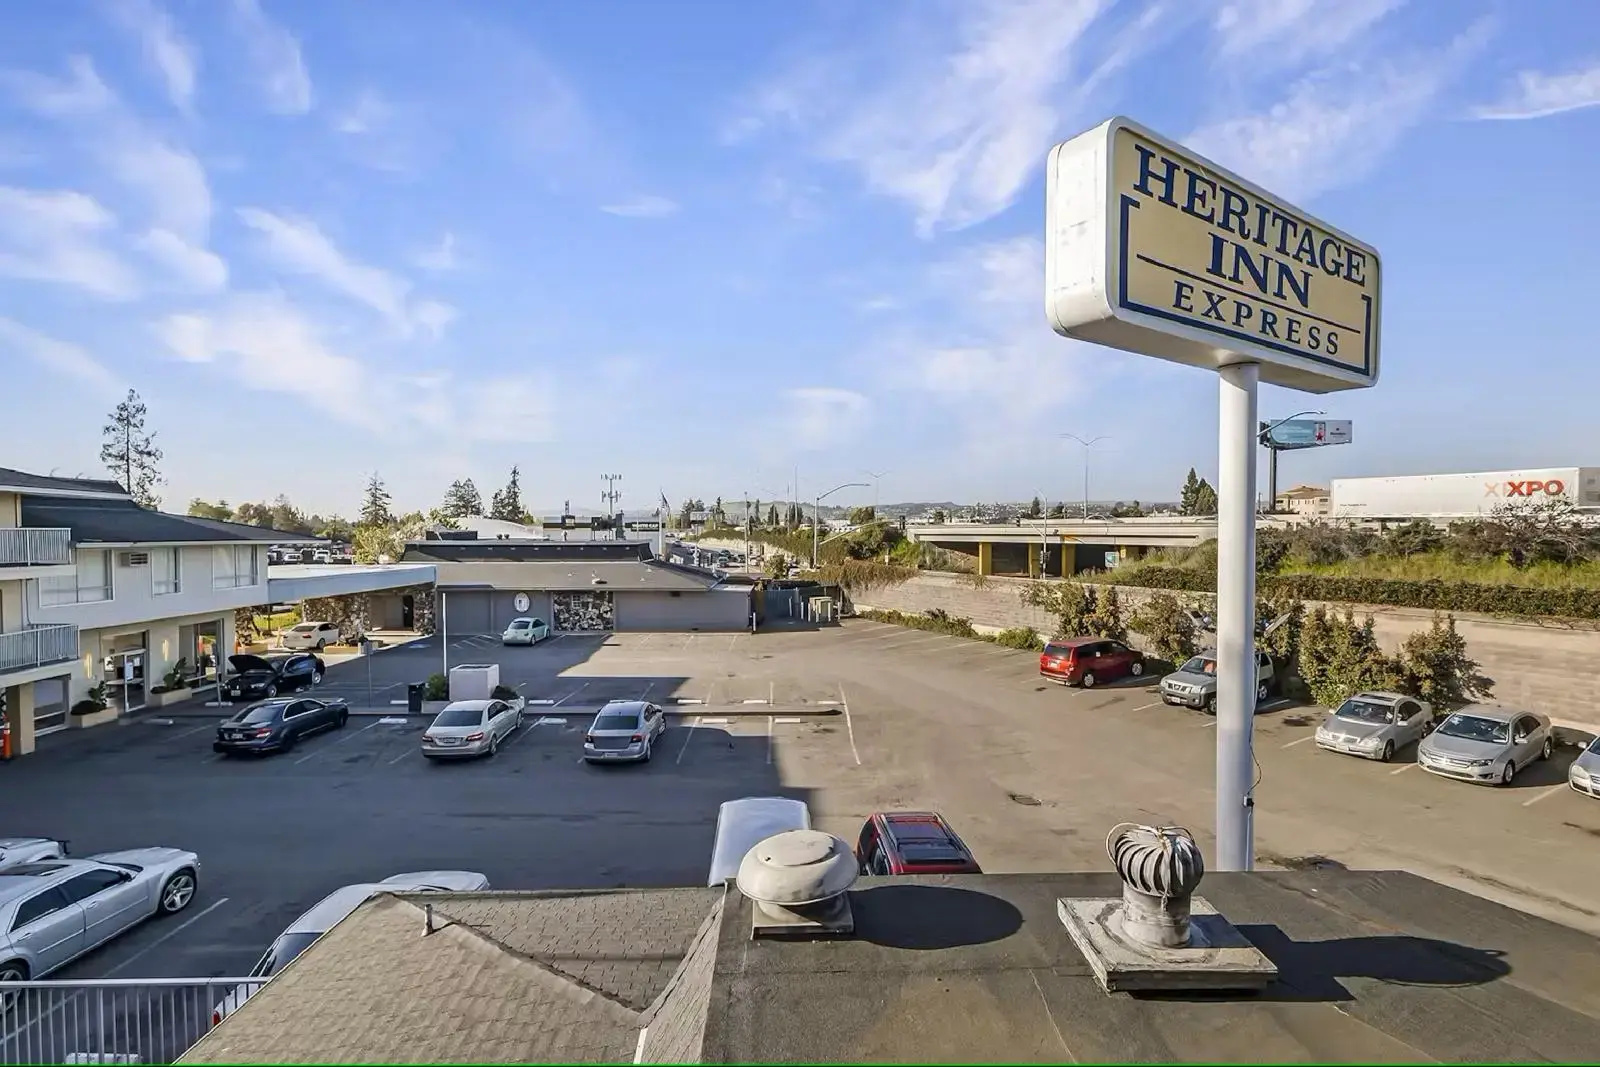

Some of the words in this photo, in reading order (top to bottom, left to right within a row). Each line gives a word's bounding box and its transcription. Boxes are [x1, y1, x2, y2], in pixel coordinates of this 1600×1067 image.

[1133, 144, 1366, 287] HERITAGE
[1206, 232, 1313, 308] INN
[1172, 281, 1339, 355] EXPRESS
[1507, 480, 1564, 497] XPO
